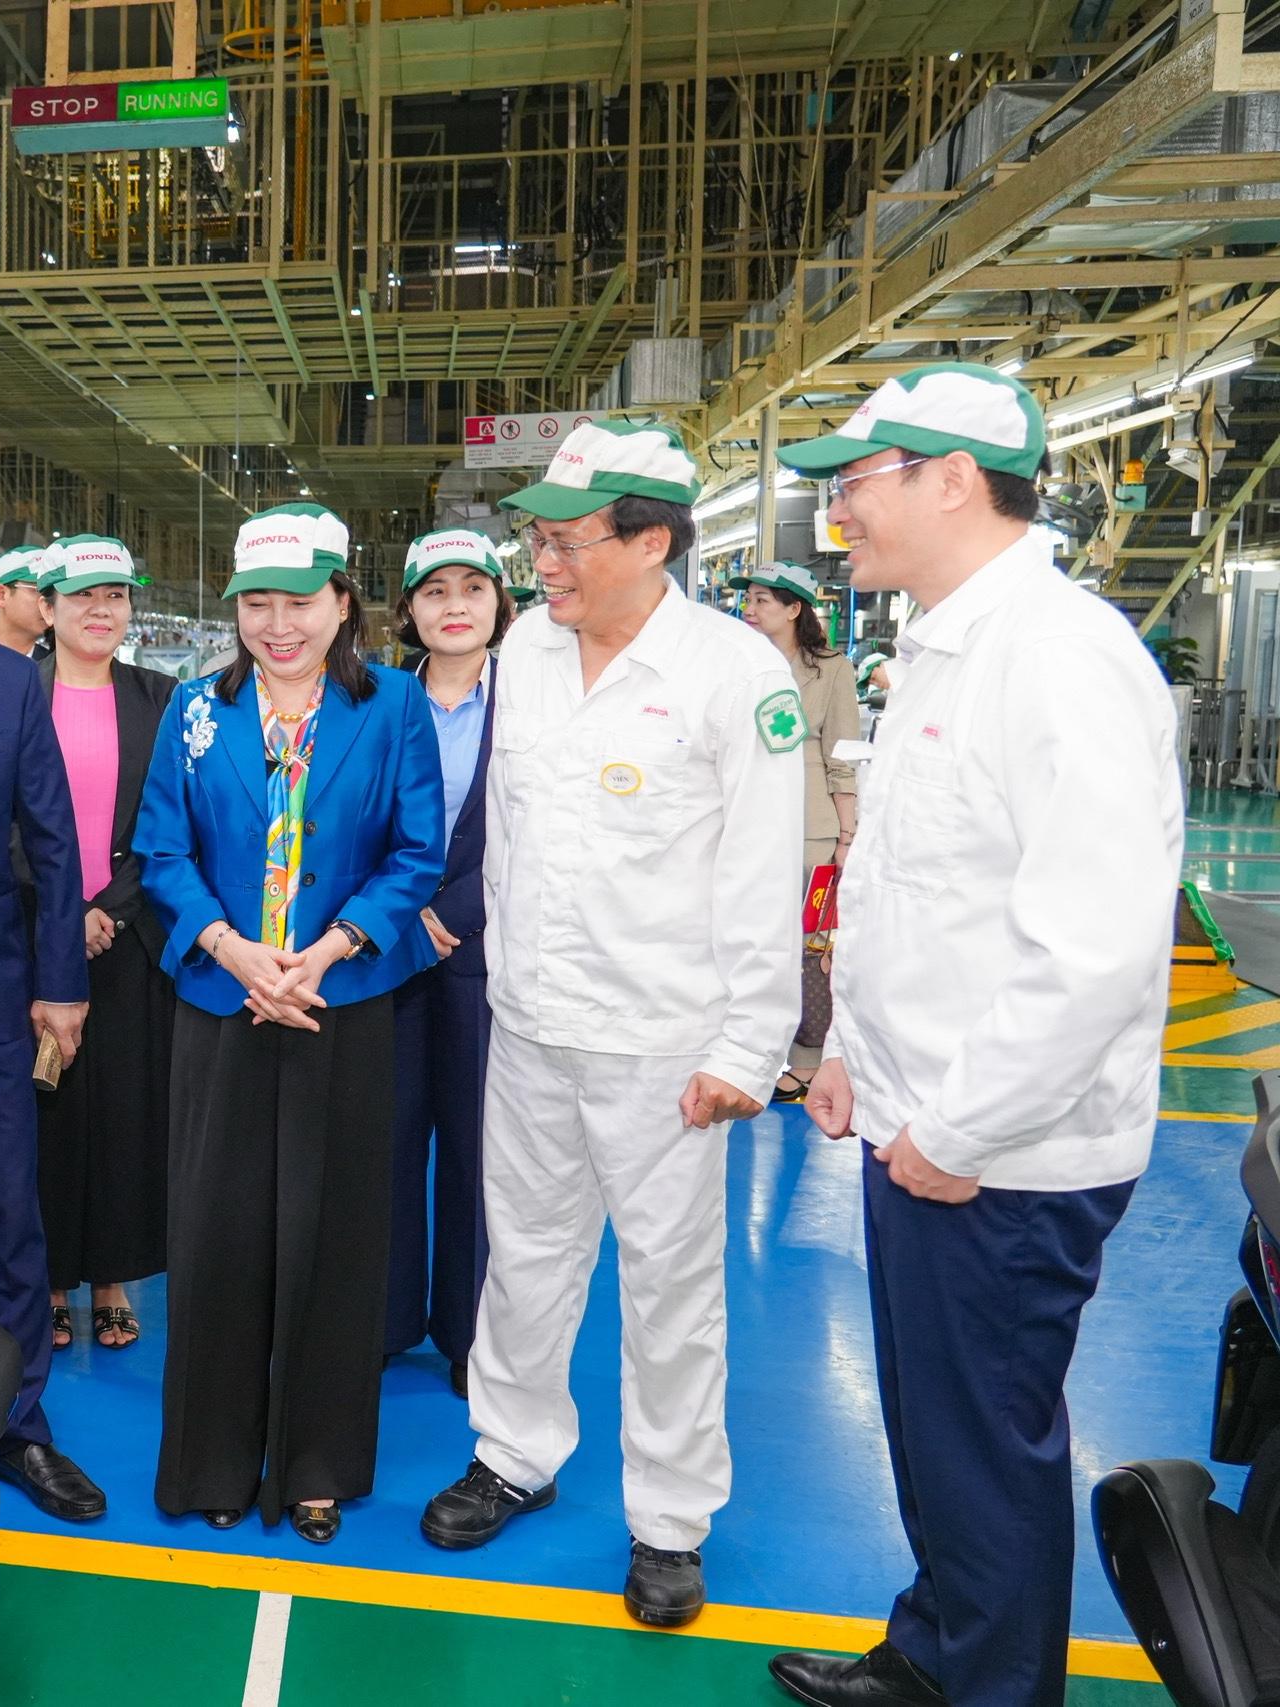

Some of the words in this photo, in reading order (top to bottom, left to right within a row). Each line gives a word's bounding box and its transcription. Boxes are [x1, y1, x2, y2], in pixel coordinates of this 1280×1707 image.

[30, 97, 99, 118] STOP
[246, 535, 300, 550] HONDA
[426, 540, 475, 553] HONDA
[75, 553, 122, 562] HONDA
